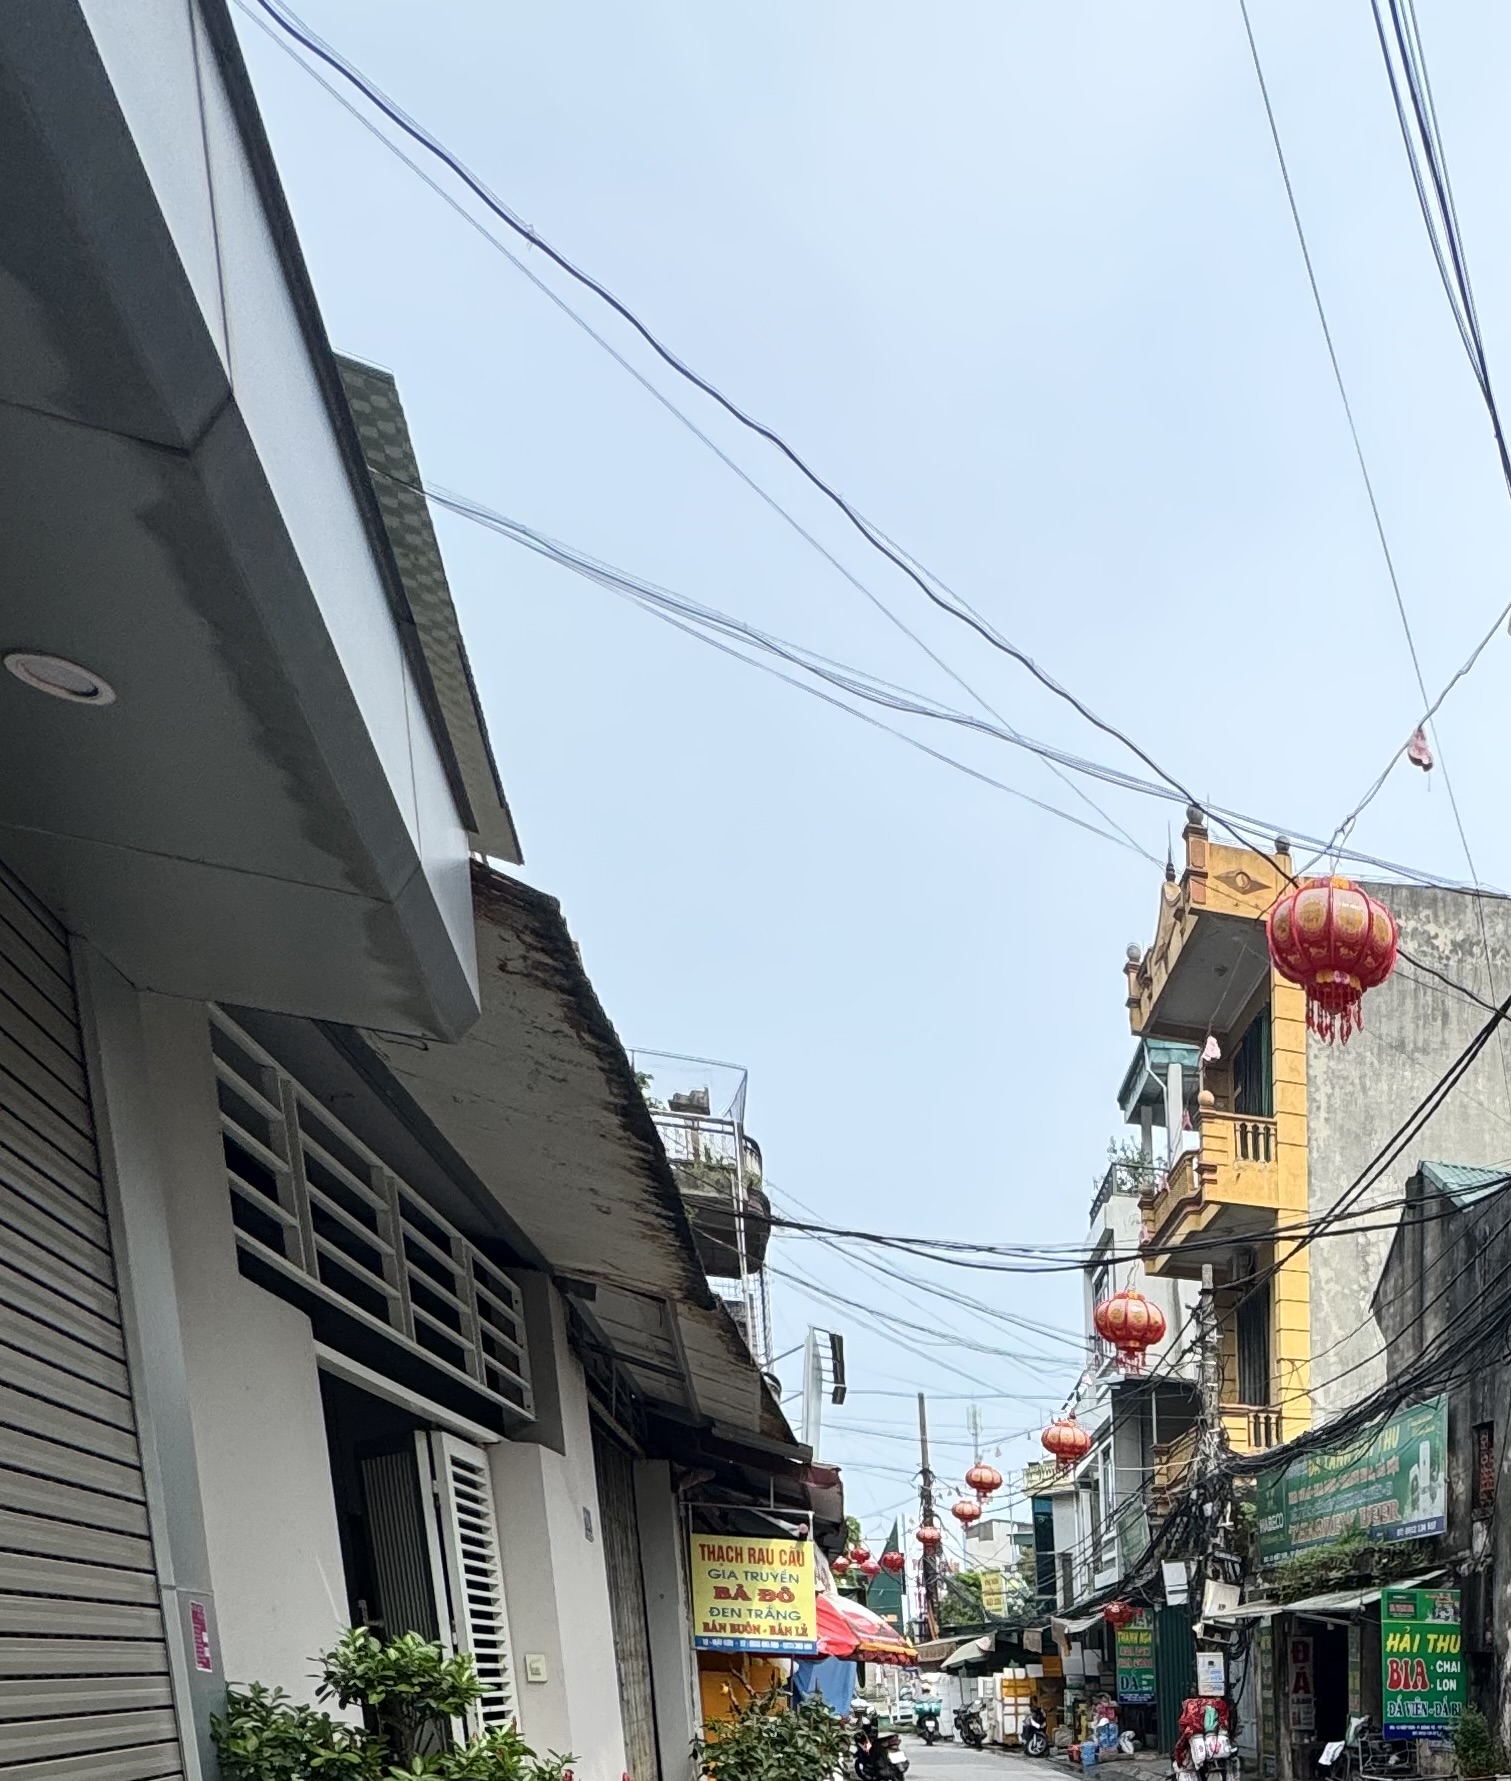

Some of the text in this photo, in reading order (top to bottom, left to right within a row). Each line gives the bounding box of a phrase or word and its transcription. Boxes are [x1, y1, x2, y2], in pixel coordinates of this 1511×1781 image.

[699, 1543, 743, 1567] THẠCH
[748, 1547, 774, 1565] RAU
[708, 1568, 738, 1580] GIA
[708, 1606, 742, 1618] ĐEN
[702, 1619, 726, 1633] BÁN
[769, 1622, 792, 1636] BÁN
[1386, 1626, 1461, 1654] HẢI THU
[1387, 1658, 1430, 1691] BIA
[1436, 1660, 1461, 1673] CHAI
[1436, 1679, 1457, 1691] LON
[1387, 1694, 1404, 1717] ĐÁ
[1404, 1696, 1428, 1717] VIÊN
